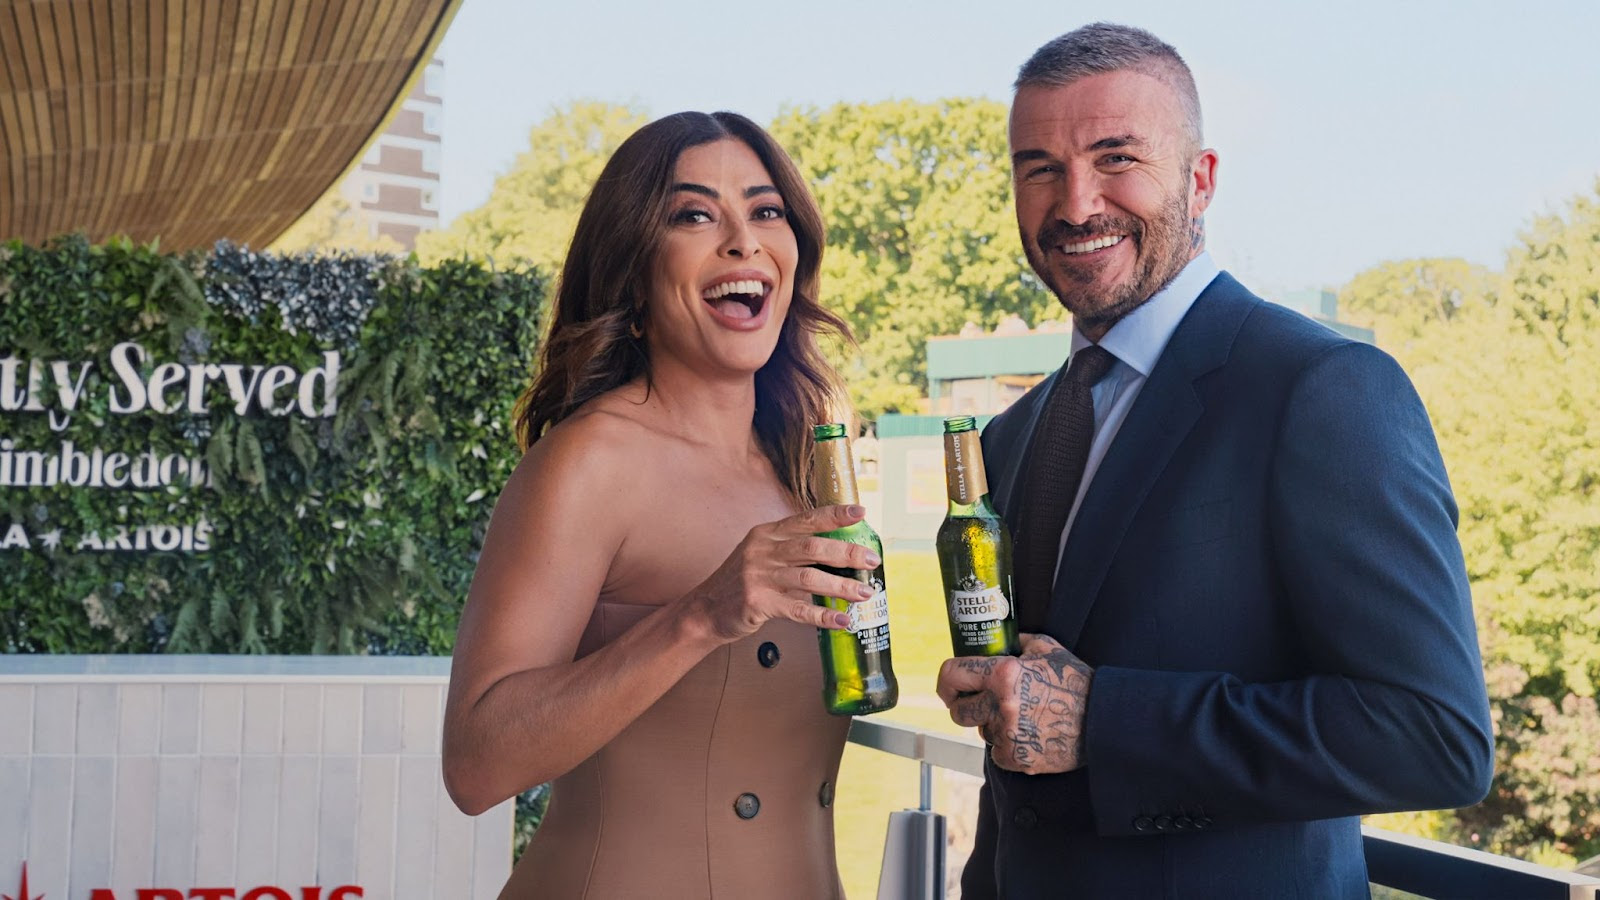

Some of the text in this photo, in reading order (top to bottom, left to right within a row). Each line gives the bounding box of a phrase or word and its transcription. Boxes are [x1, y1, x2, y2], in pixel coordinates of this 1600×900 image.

[109, 342, 340, 418] Served
[954, 435, 967, 499] STELLA ARTOIS
[856, 599, 887, 613] STELLA
[956, 594, 997, 606] STELLA
[857, 608, 888, 622] ARTOIS
[957, 603, 998, 616] ARTOIS
[958, 620, 1001, 632] PURE GOLD
[857, 628, 878, 640] PURE
